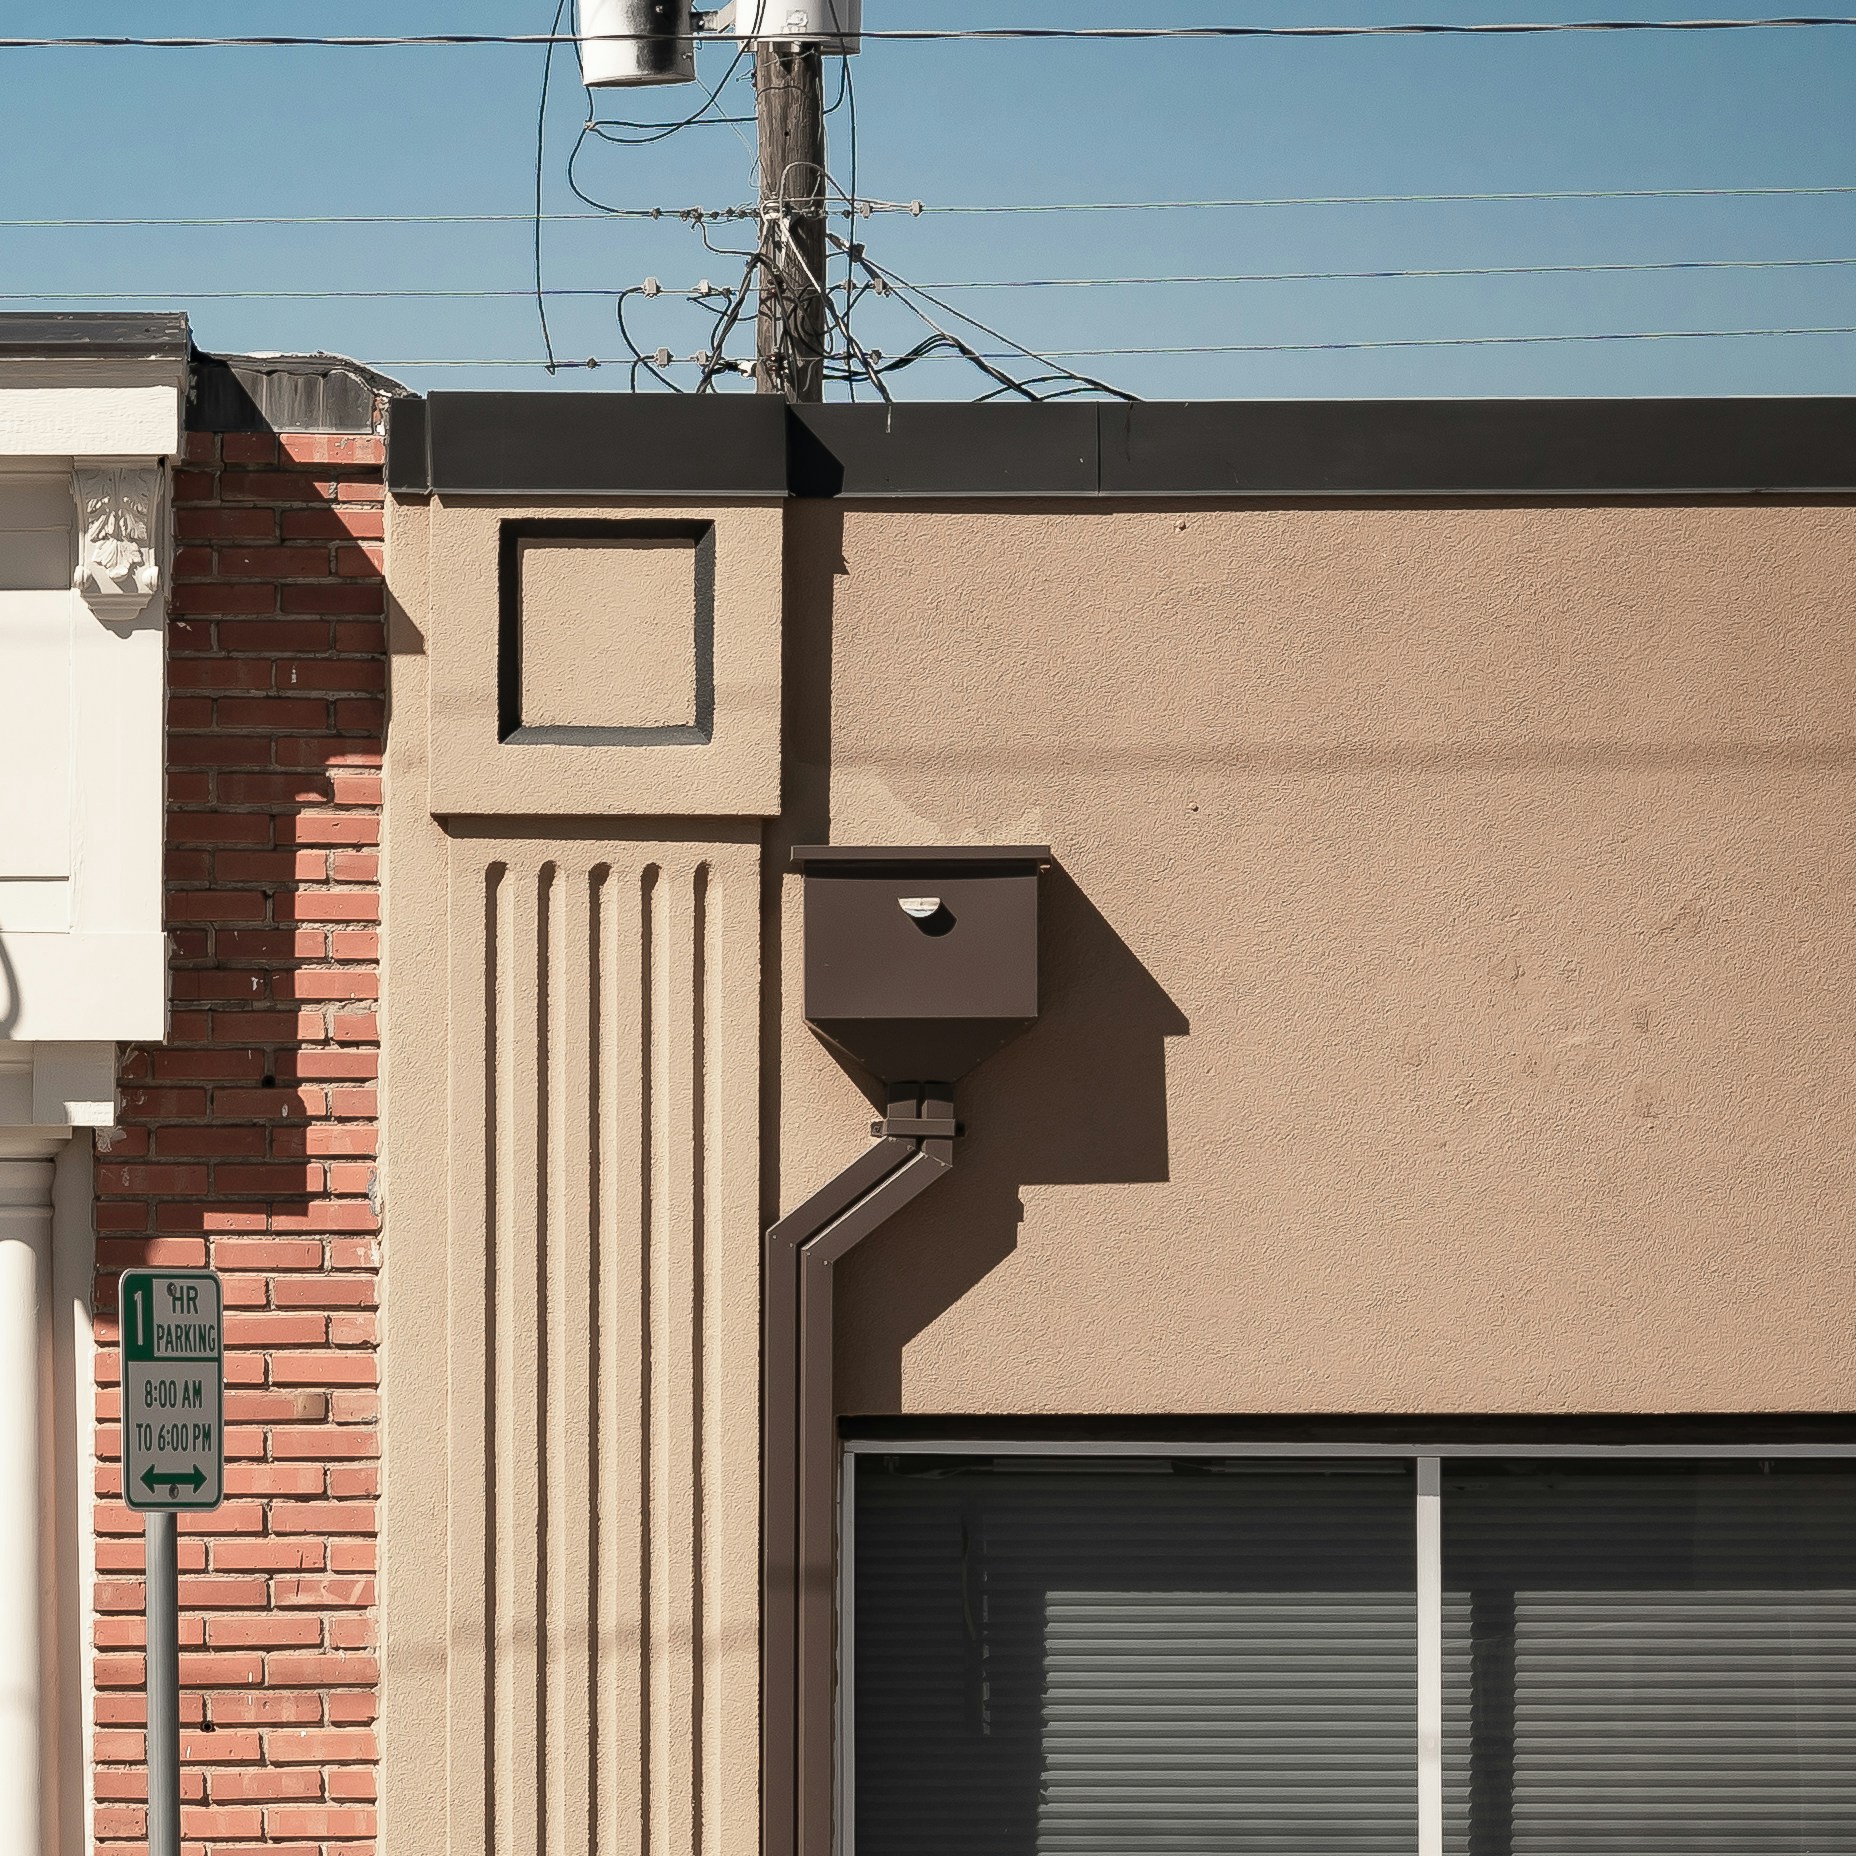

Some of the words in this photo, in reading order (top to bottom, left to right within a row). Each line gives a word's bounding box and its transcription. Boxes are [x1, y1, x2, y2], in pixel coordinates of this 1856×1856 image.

[133, 1290, 144, 1346] 1
[171, 1285, 199, 1315] HR
[155, 1323, 216, 1353] PARKING
[144, 1379, 177, 1409] 8:00
[181, 1380, 203, 1409] AM
[136, 1422, 153, 1452] TO
[157, 1423, 189, 1452] 6:00
[192, 1422, 212, 1452] PM
